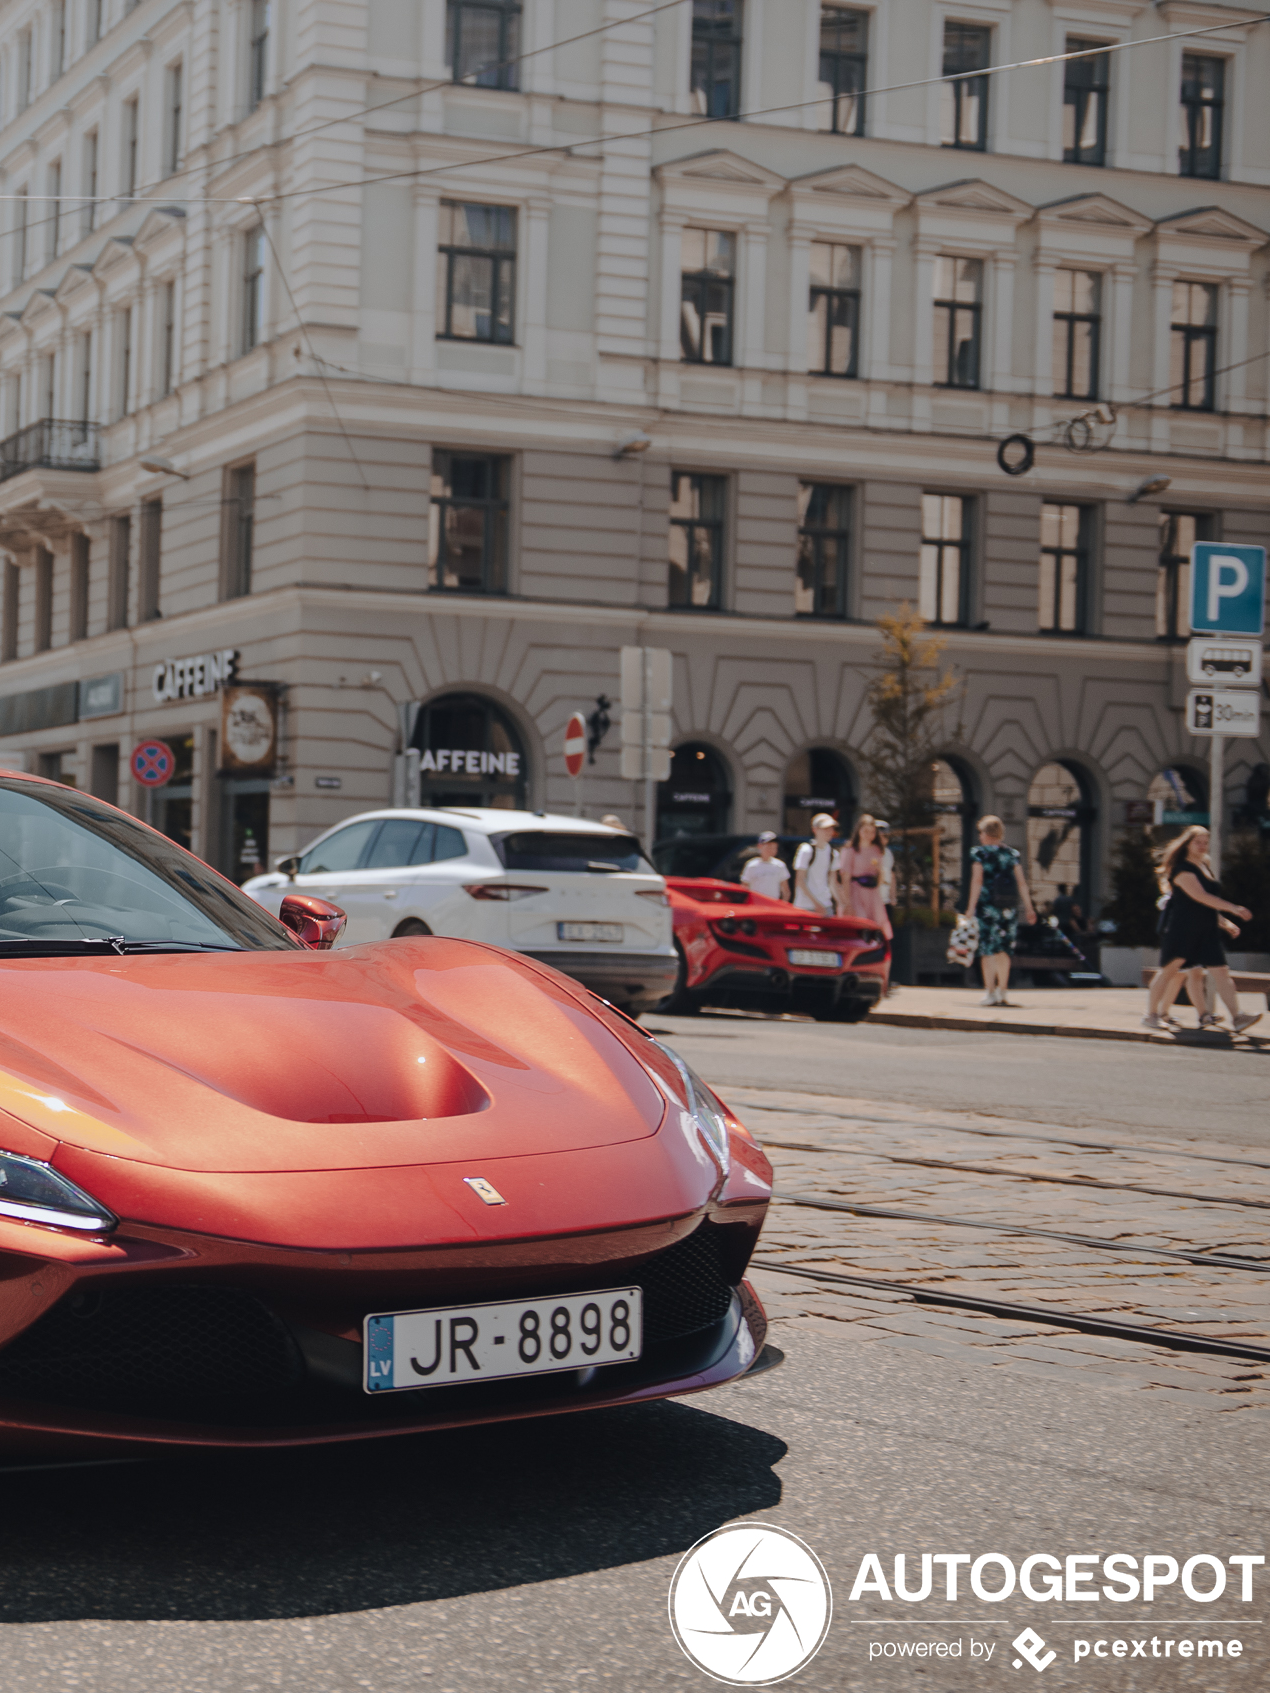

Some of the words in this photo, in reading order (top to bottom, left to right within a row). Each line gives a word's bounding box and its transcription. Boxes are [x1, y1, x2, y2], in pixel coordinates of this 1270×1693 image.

[1207, 554, 1249, 622] P
[153, 649, 235, 702] CAFFEINE
[370, 1360, 392, 1377] LV
